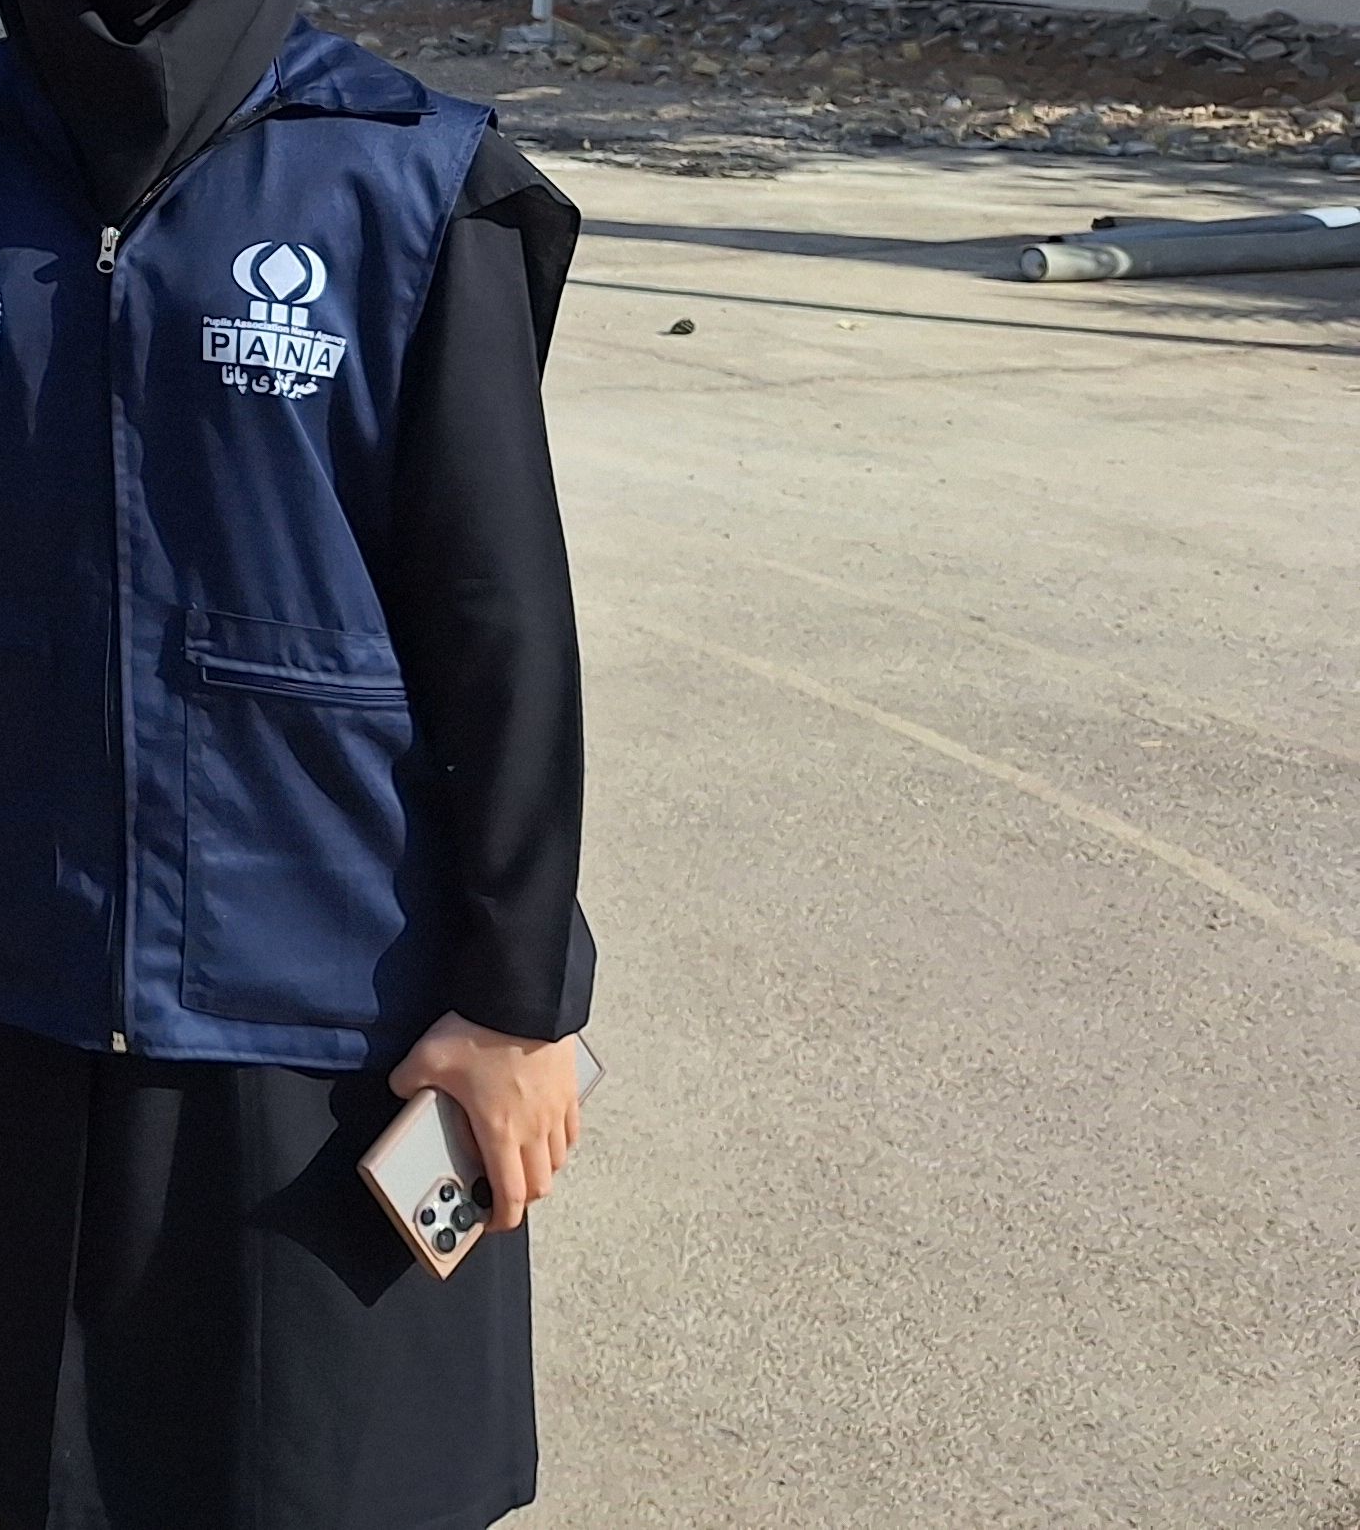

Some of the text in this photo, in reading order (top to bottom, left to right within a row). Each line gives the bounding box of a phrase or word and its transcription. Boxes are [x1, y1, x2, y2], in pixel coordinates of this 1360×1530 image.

[203, 316, 233, 329] Pupils
[233, 318, 290, 335] Association
[206, 329, 338, 375] PANA
[221, 365, 320, 400] خبرگزاری پانا
